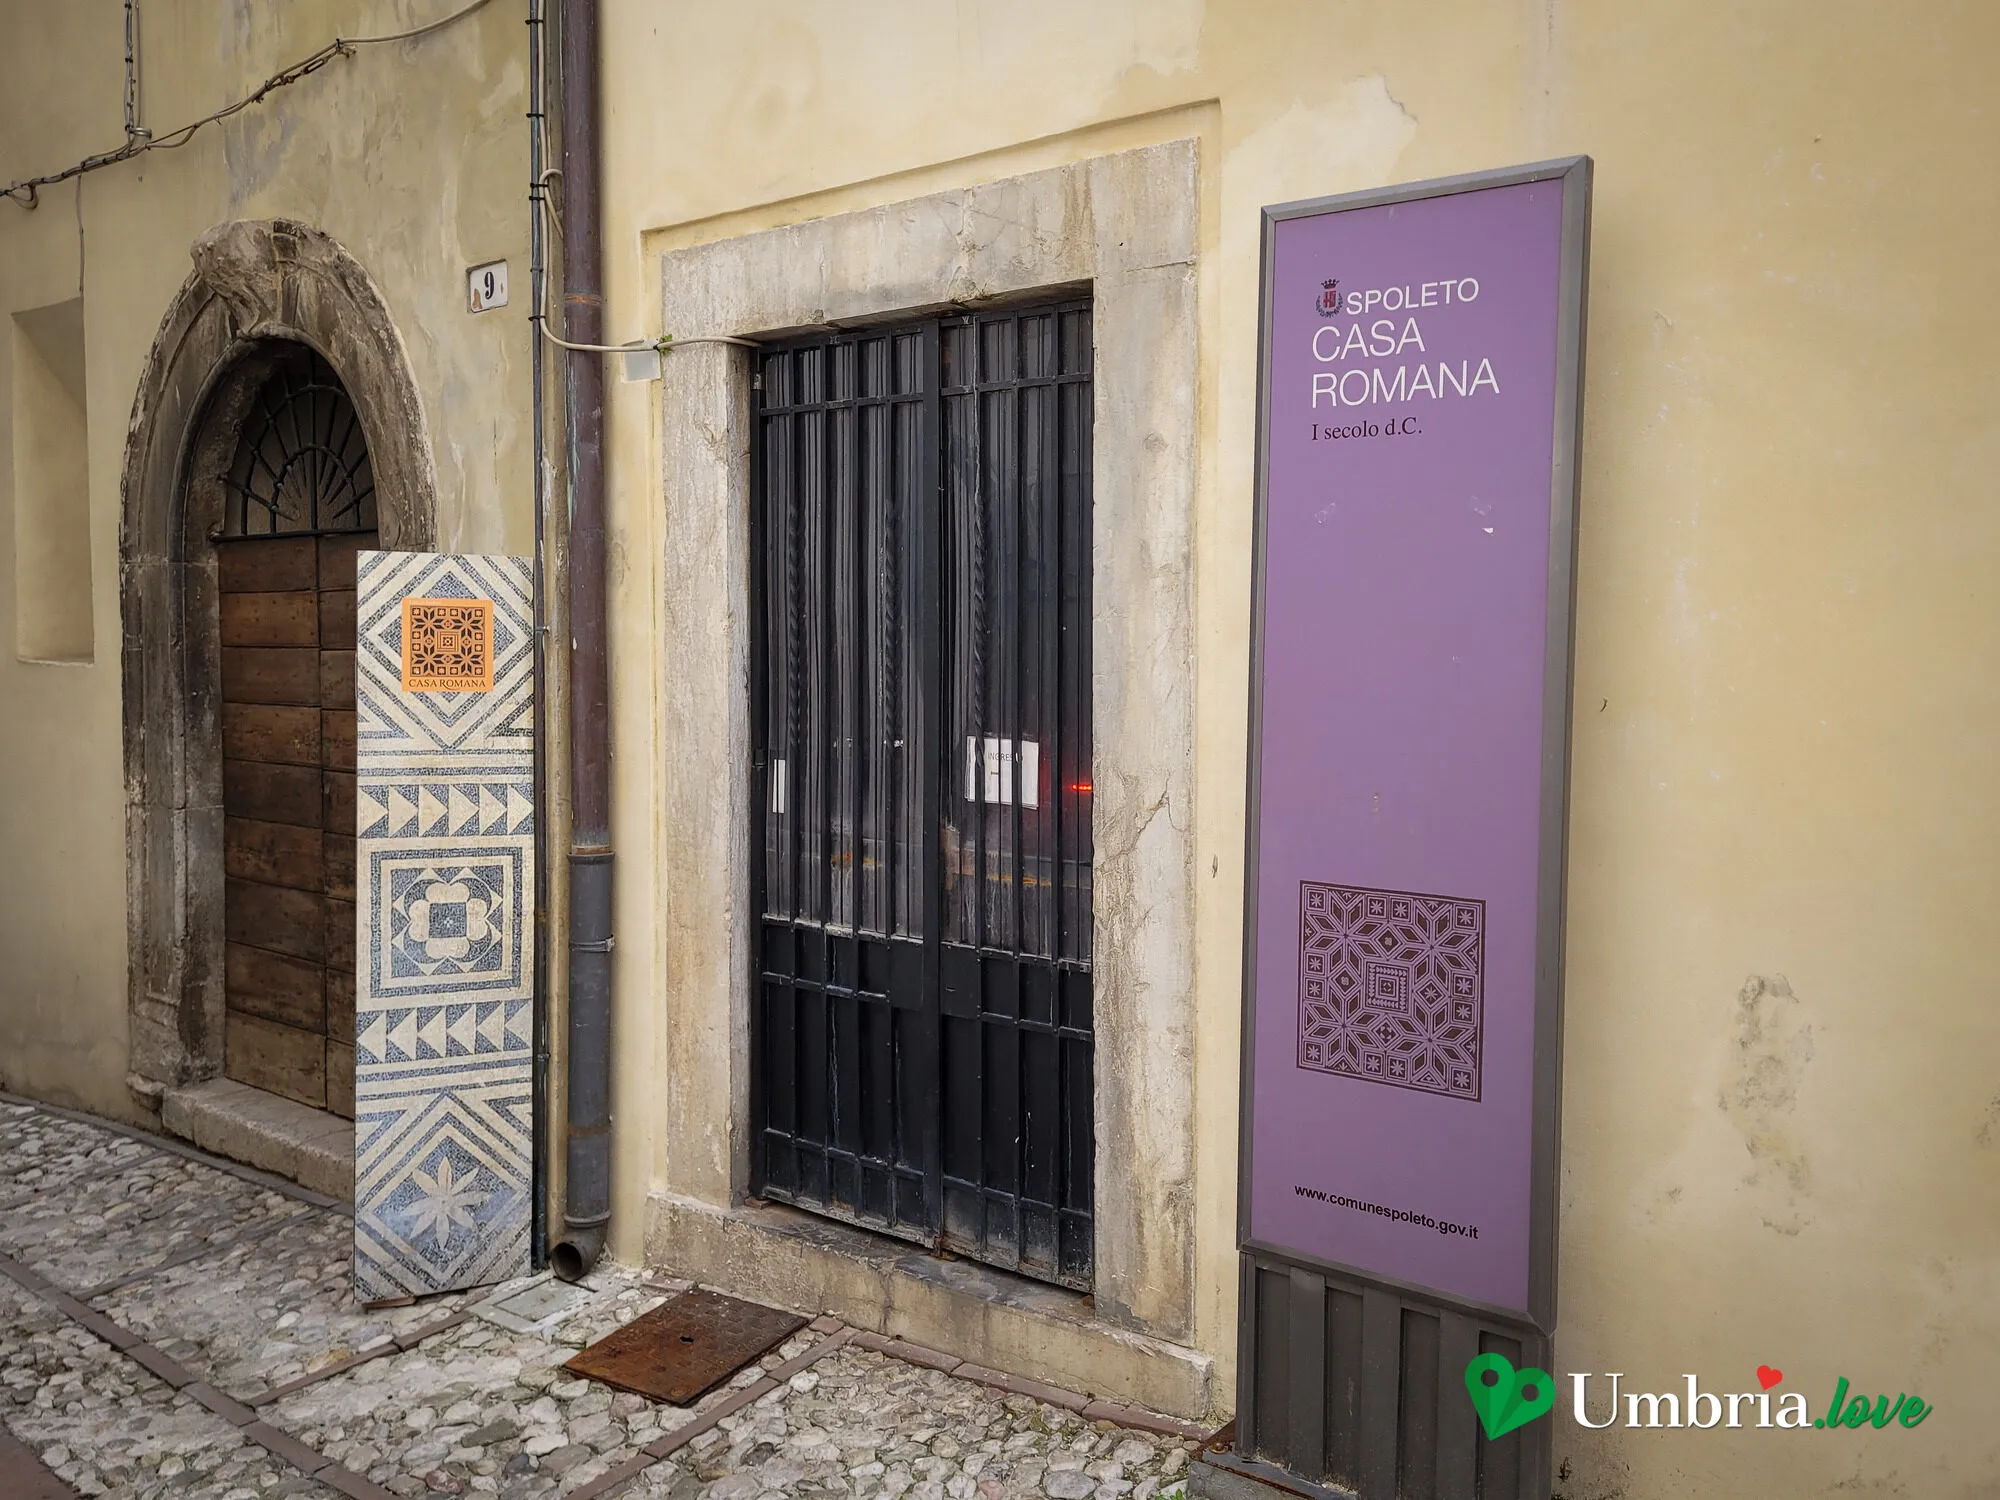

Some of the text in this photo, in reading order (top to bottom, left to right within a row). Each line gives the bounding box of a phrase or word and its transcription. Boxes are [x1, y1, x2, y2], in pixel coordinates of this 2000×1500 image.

[484, 271, 495, 300] 9
[1346, 277, 1480, 315] SPOLETO
[1312, 317, 1426, 362] CASA
[1312, 358, 1501, 409] ROMANA
[1311, 416, 1423, 441] I secolo d.C.
[408, 679, 486, 691] CASA ROMANA
[1294, 1184, 1480, 1240] www.comunespoleto.gov.it
